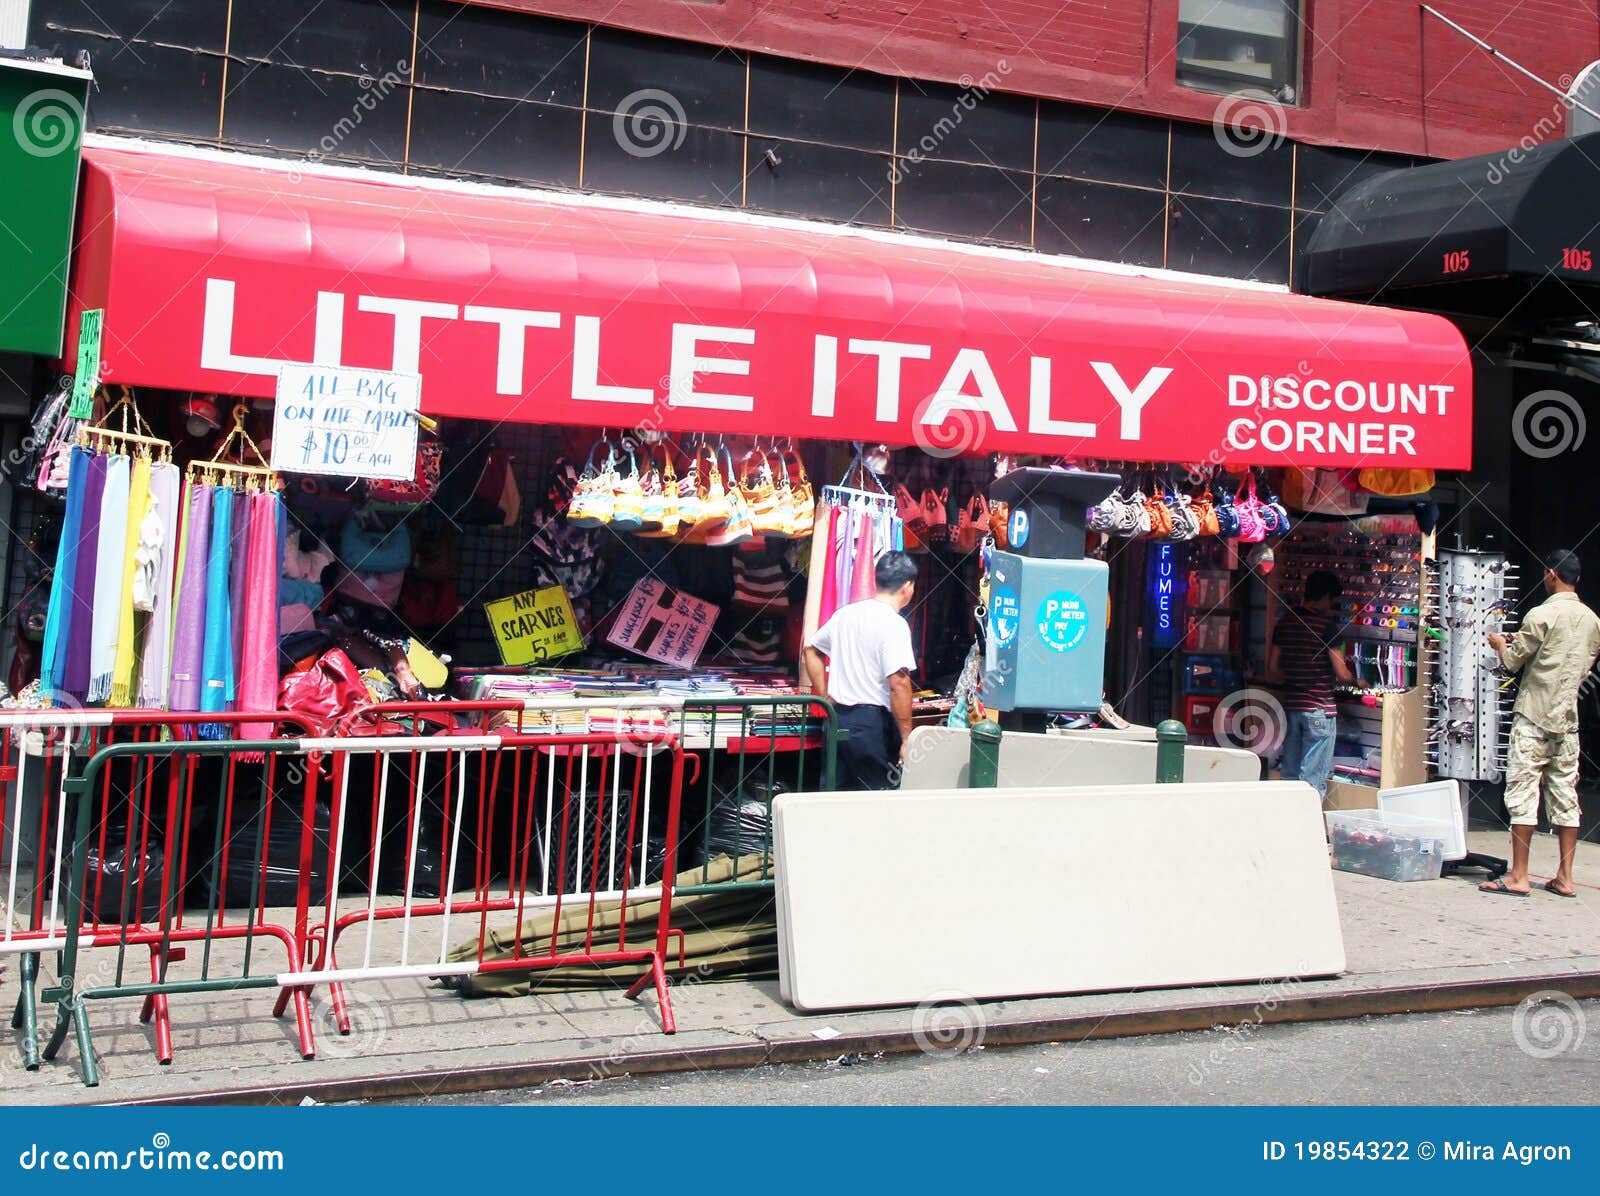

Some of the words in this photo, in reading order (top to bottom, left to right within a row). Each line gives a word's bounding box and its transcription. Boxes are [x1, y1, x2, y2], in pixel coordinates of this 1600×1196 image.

[1442, 250, 1470, 273] 105
[1561, 247, 1592, 271] 105
[200, 278, 756, 412] LITTLE
[811, 335, 1174, 441] ITALY
[302, 375, 338, 401] ALL
[356, 378, 397, 404] BAG
[1227, 374, 1455, 416] DISCOUNT
[284, 405, 314, 421] ON
[1227, 417, 1417, 455] CORNER
[1011, 510, 1028, 545] P
[513, 591, 536, 612] ANY
[1046, 599, 1059, 618] P
[501, 605, 566, 640] SCARVES
